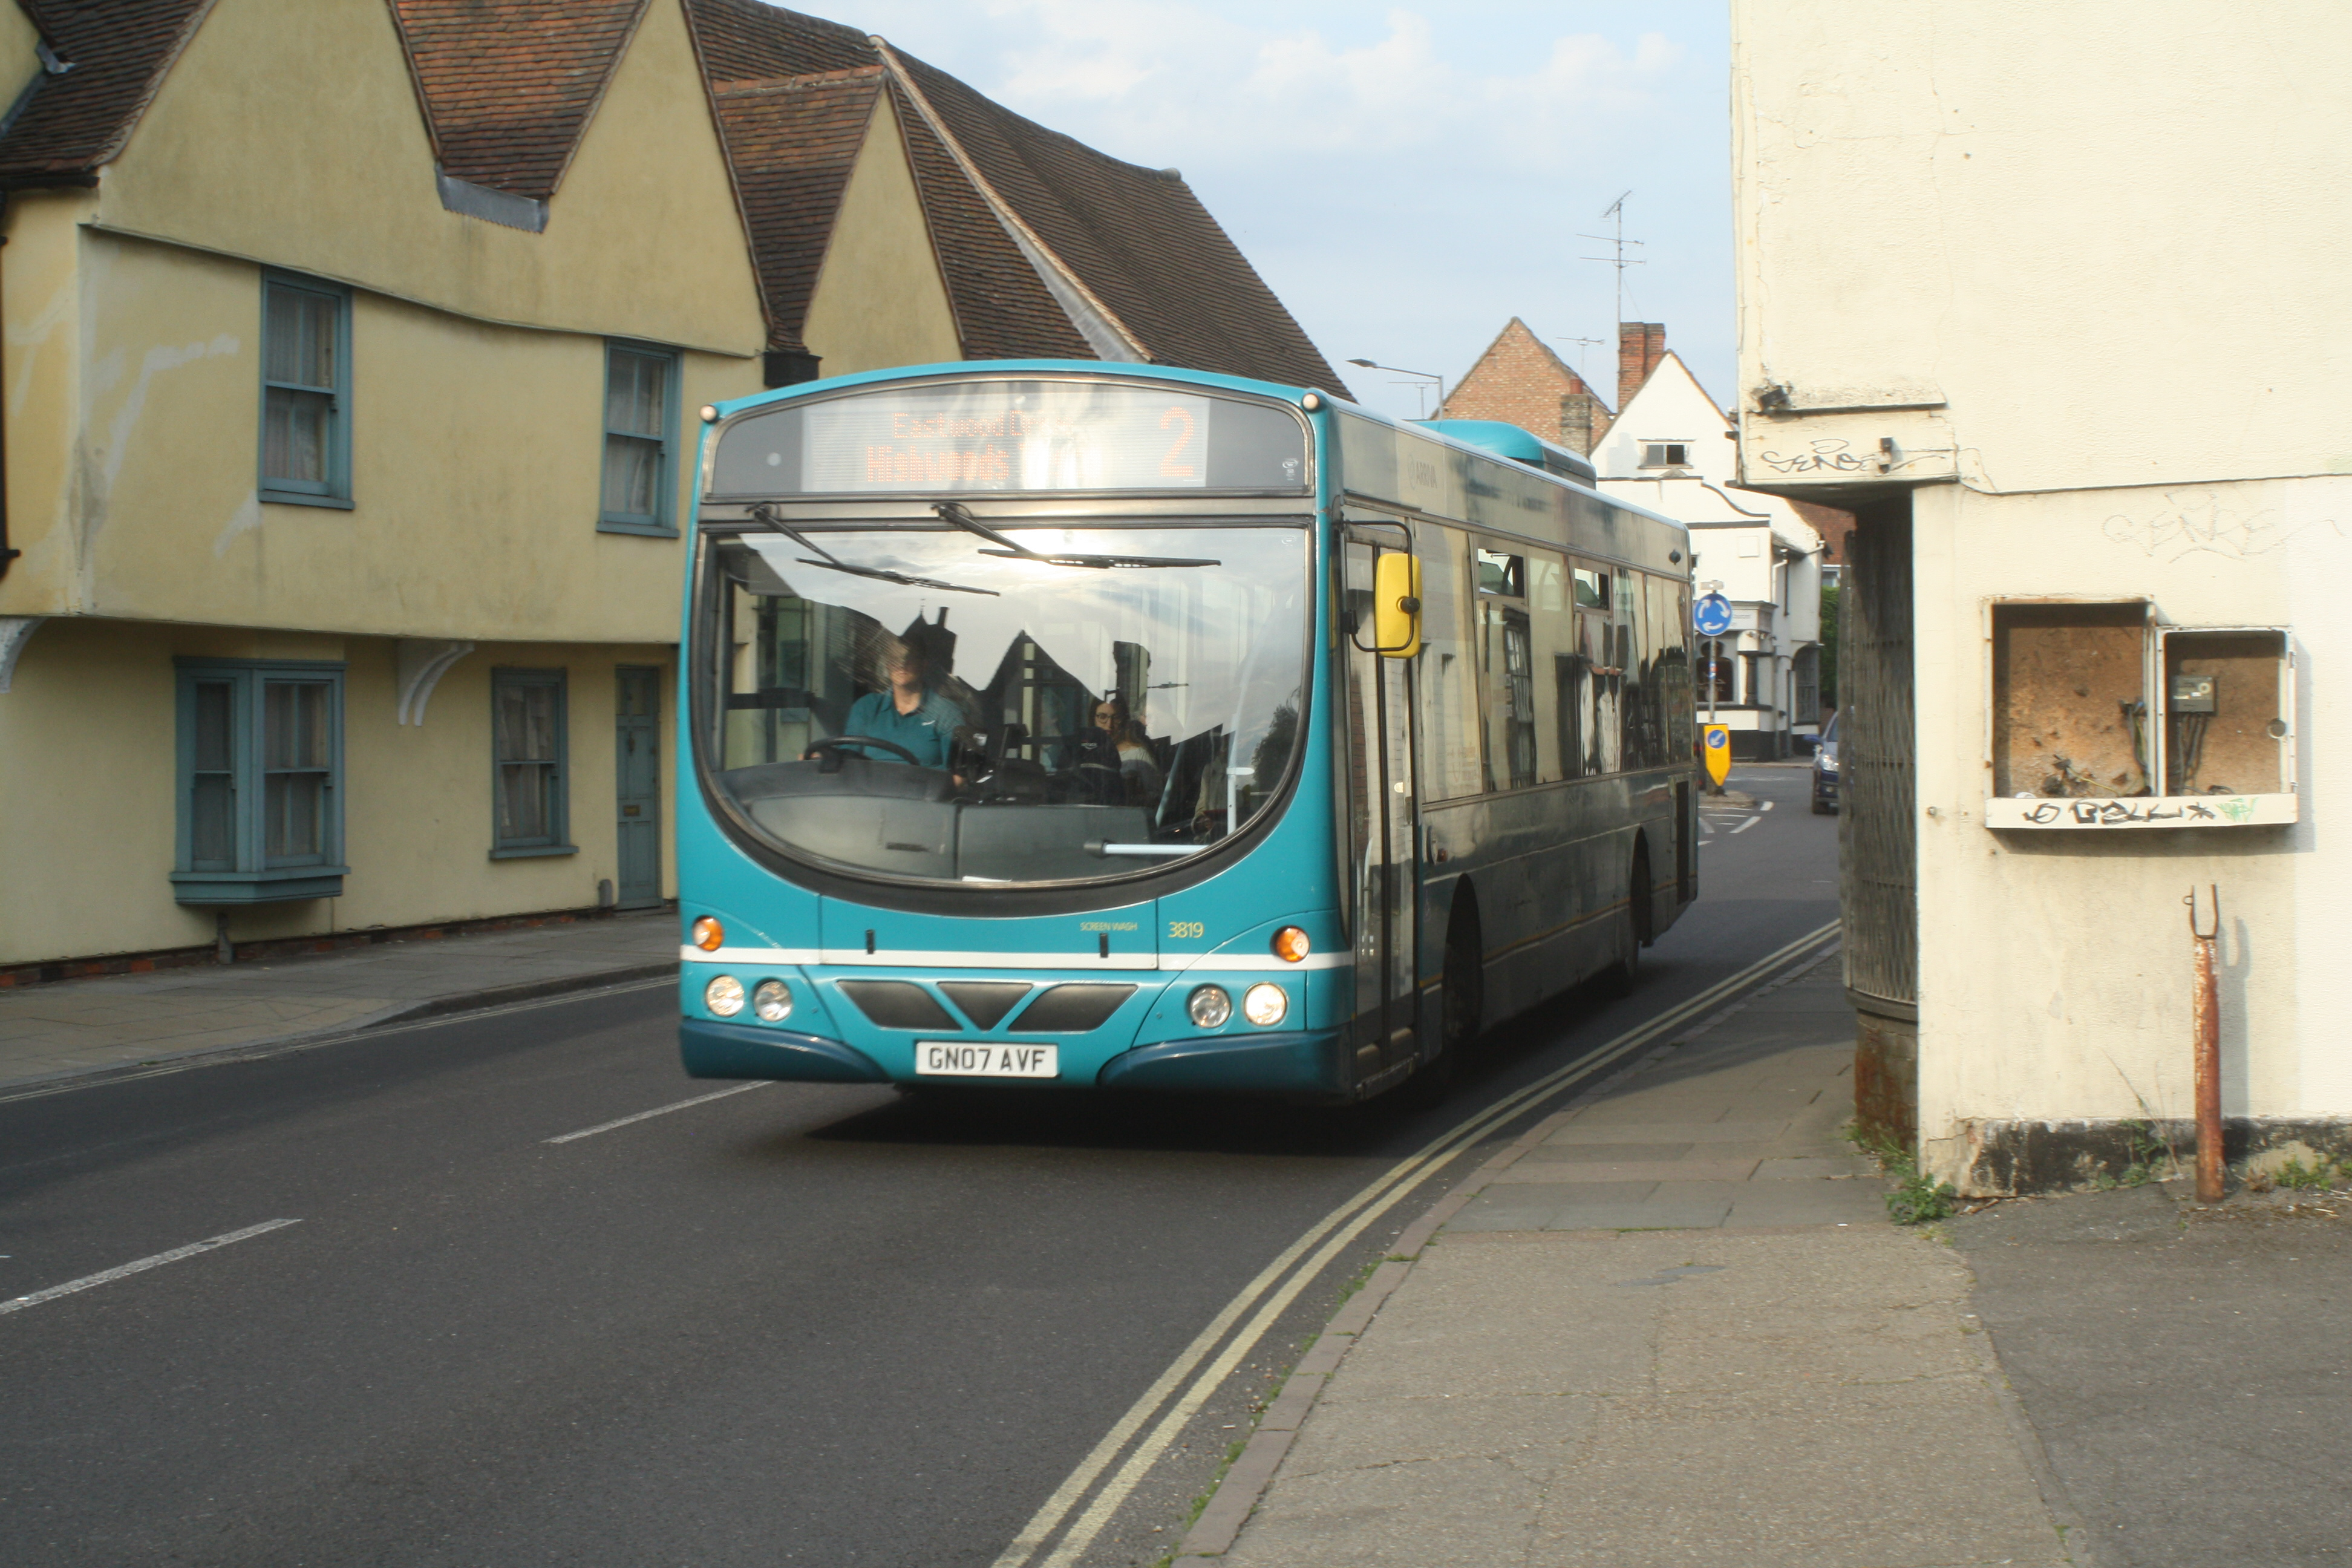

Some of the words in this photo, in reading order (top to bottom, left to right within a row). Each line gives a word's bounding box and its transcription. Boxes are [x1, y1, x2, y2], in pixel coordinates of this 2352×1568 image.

[893, 410, 1005, 438] Eastwood
[1160, 407, 1194, 477] 2
[1416, 461, 1437, 489] ARRIVA
[1080, 921, 1111, 931] SCREEN
[1112, 922, 1138, 932] WASH
[1168, 921, 1204, 938] 3819
[929, 1047, 992, 1071] GN07
[1000, 1048, 1047, 1072] AVF
